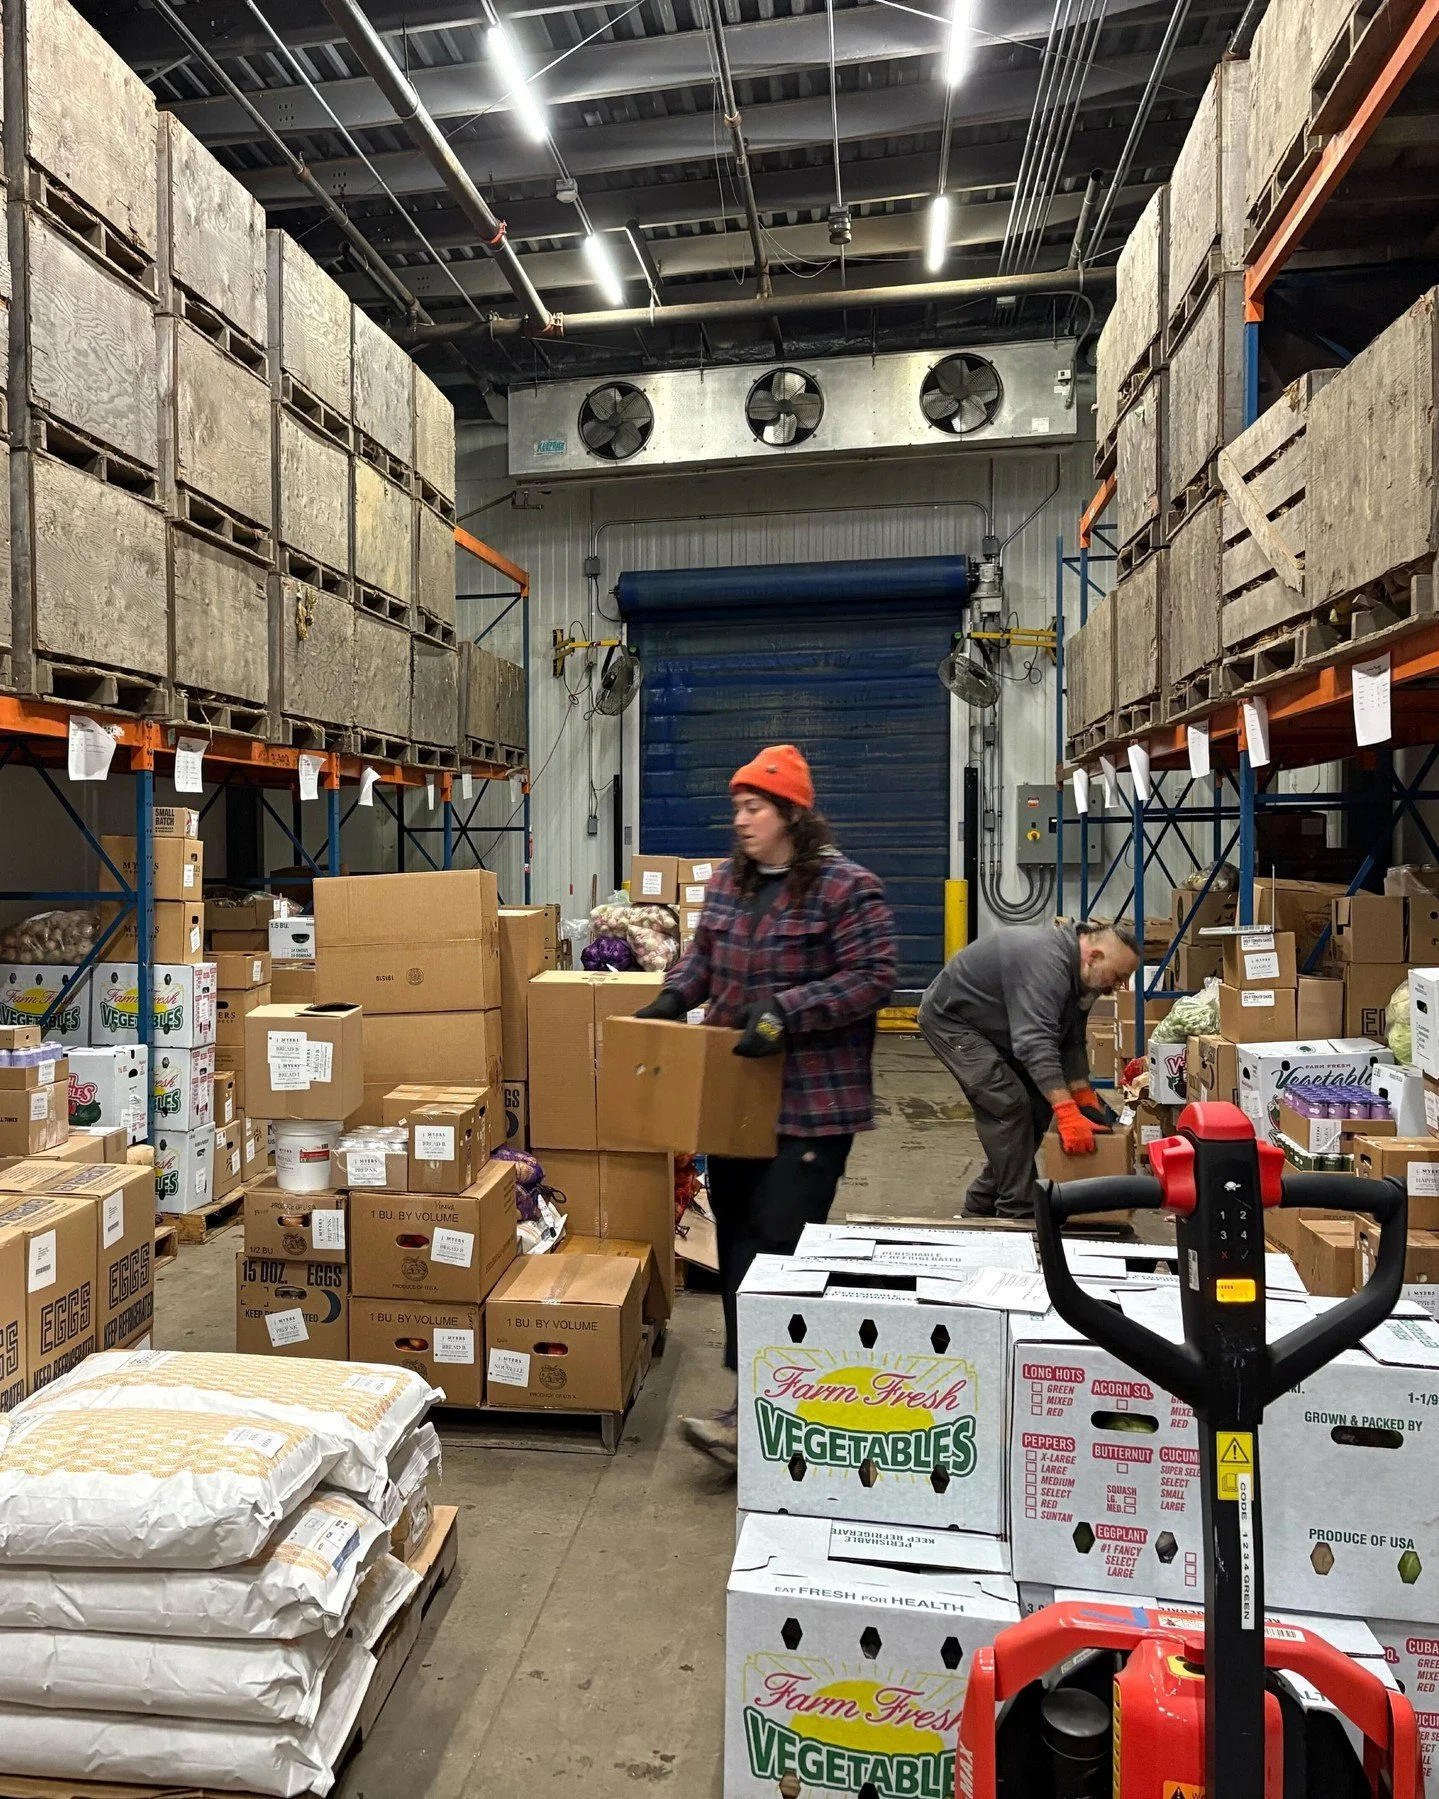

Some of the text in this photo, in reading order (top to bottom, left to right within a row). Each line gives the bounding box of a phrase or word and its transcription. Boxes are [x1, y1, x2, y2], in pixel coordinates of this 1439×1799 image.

[155, 808, 175, 817] SMALL
[155, 817, 175, 826] BATCH
[124, 925, 159, 934] MYS
[3, 989, 37, 1004] Farm
[0, 1002, 81, 1032] VEGETBLES
[218, 1011, 236, 1019] ERS
[504, 1088, 520, 1108] GS
[371, 1210, 375, 1218] 1
[399, 1211, 413, 1221] BY
[415, 1212, 460, 1223] VOLUME
[1220, 1210, 1247, 1220] 1 2
[1220, 1230, 1247, 1240] 3 4
[889, 1255, 963, 1263] REFRIGERATED
[109, 1241, 150, 1311] EGGS
[242, 1260, 342, 1287] 15 DOZ. EGGS
[40, 1281, 91, 1356] EGGS
[104, 1290, 153, 1350] KEEP REFRIGERATED
[245, 1309, 263, 1318] KEEP
[278, 1316, 296, 1324] MYERS
[370, 1313, 375, 1322] 1
[397, 1314, 411, 1324] BY
[413, 1315, 458, 1327] VOLUME
[507, 1318, 598, 1331] 1 BY VOLUME
[33, 1364, 51, 1392] KEEP
[1025, 1366, 1084, 1382] LONG HOTS
[764, 1366, 968, 1411] Farm Fresh
[1046, 1384, 1075, 1395] GREEN
[1094, 1382, 1153, 1399] ACORN SQ.
[1046, 1396, 1074, 1407] MIXED
[1046, 1407, 1064, 1417] RED
[1171, 1406, 1195, 1417] MIXE
[1170, 1418, 1189, 1429] RED
[1304, 1411, 1423, 1432] GROWN & PACKED BY
[755, 1397, 978, 1477] VEGETABLES
[1024, 1435, 1074, 1451] PEPPERS
[1040, 1453, 1077, 1465] X-LARGE
[1095, 1445, 1152, 1462] BUTTERNUT
[1162, 1449, 1200, 1464] CUCUM
[1041, 1464, 1068, 1476] LARGE
[1160, 1465, 1201, 1477] SUPER SELE
[1041, 1476, 1076, 1488] MEDIUM
[1160, 1477, 1190, 1488] SELECT
[1040, 1487, 1072, 1499] SELECT
[1106, 1485, 1137, 1496] SQUASH
[1160, 1489, 1185, 1500] SMALL
[1040, 1499, 1058, 1509] RED
[1106, 1495, 1118, 1504] LG.
[1160, 1500, 1186, 1512] LARGE
[1106, 1503, 1124, 1514] MED.
[1040, 1510, 1073, 1523] SUNTAN
[1239, 1482, 1247, 1521] CODE
[1244, 1563, 1250, 1571] 4
[831, 1527, 935, 1545] KEEP REFRIGERATE
[1097, 1526, 1147, 1542] EGGPLANT
[1308, 1528, 1415, 1550] PRODUCE OF USA
[844, 1536, 913, 1549] PERISHABLE
[1101, 1543, 1143, 1557] #1 FANCY
[1105, 1555, 1137, 1568] SELECT
[1107, 1566, 1135, 1579] LARGE
[775, 1586, 965, 1613] EAT FRESH FOR HEALTH
[1417, 1682, 1436, 1693] RED
[754, 1672, 860, 1718] Farm
